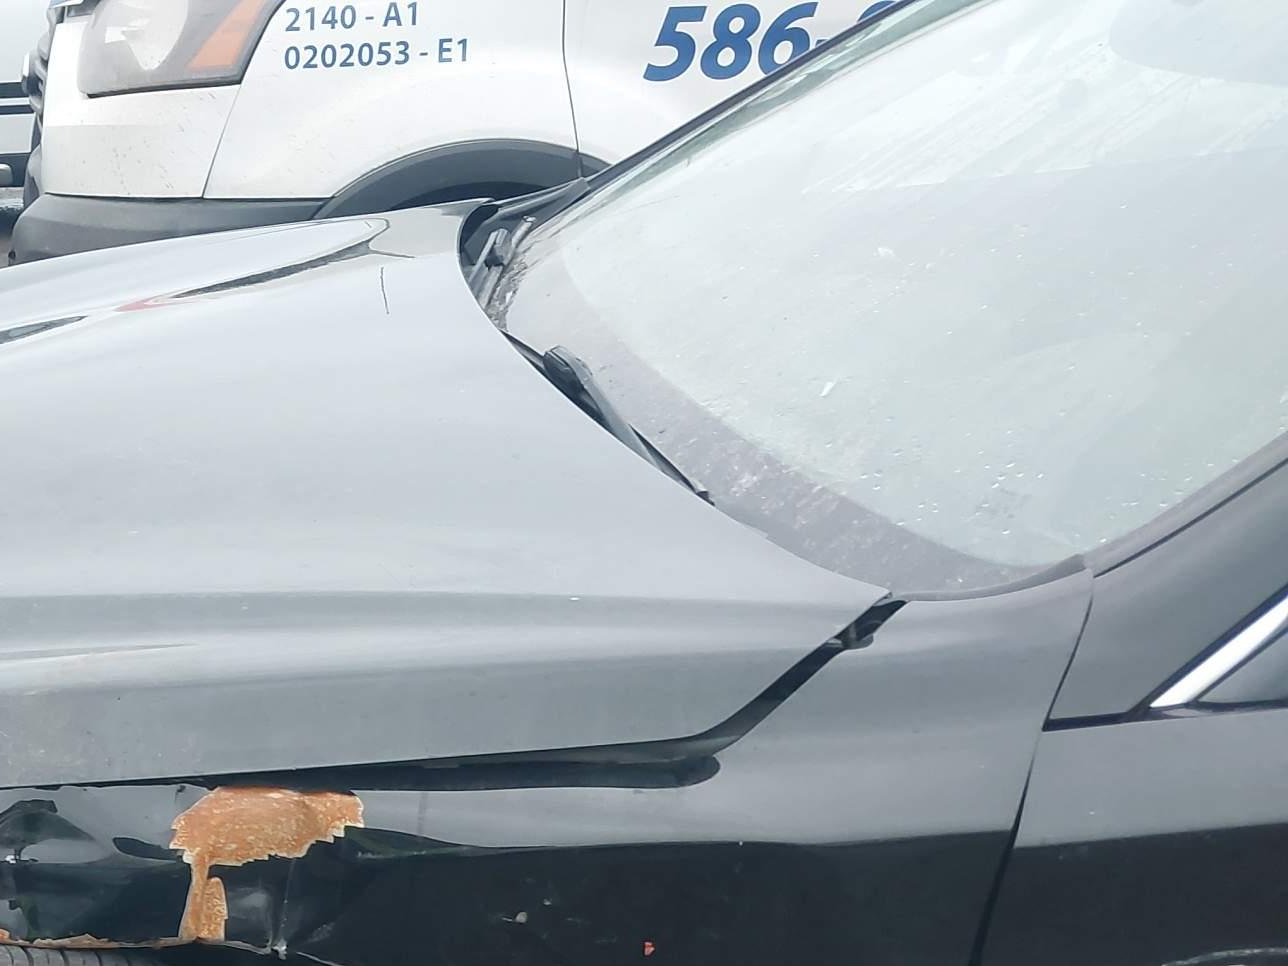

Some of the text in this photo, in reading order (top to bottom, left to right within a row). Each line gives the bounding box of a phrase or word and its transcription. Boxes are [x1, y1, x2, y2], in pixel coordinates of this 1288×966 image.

[285, 5, 357, 32] 2140
[382, 2, 418, 27] A1
[284, 41, 410, 70] 0202053
[438, 38, 468, 62] E1
